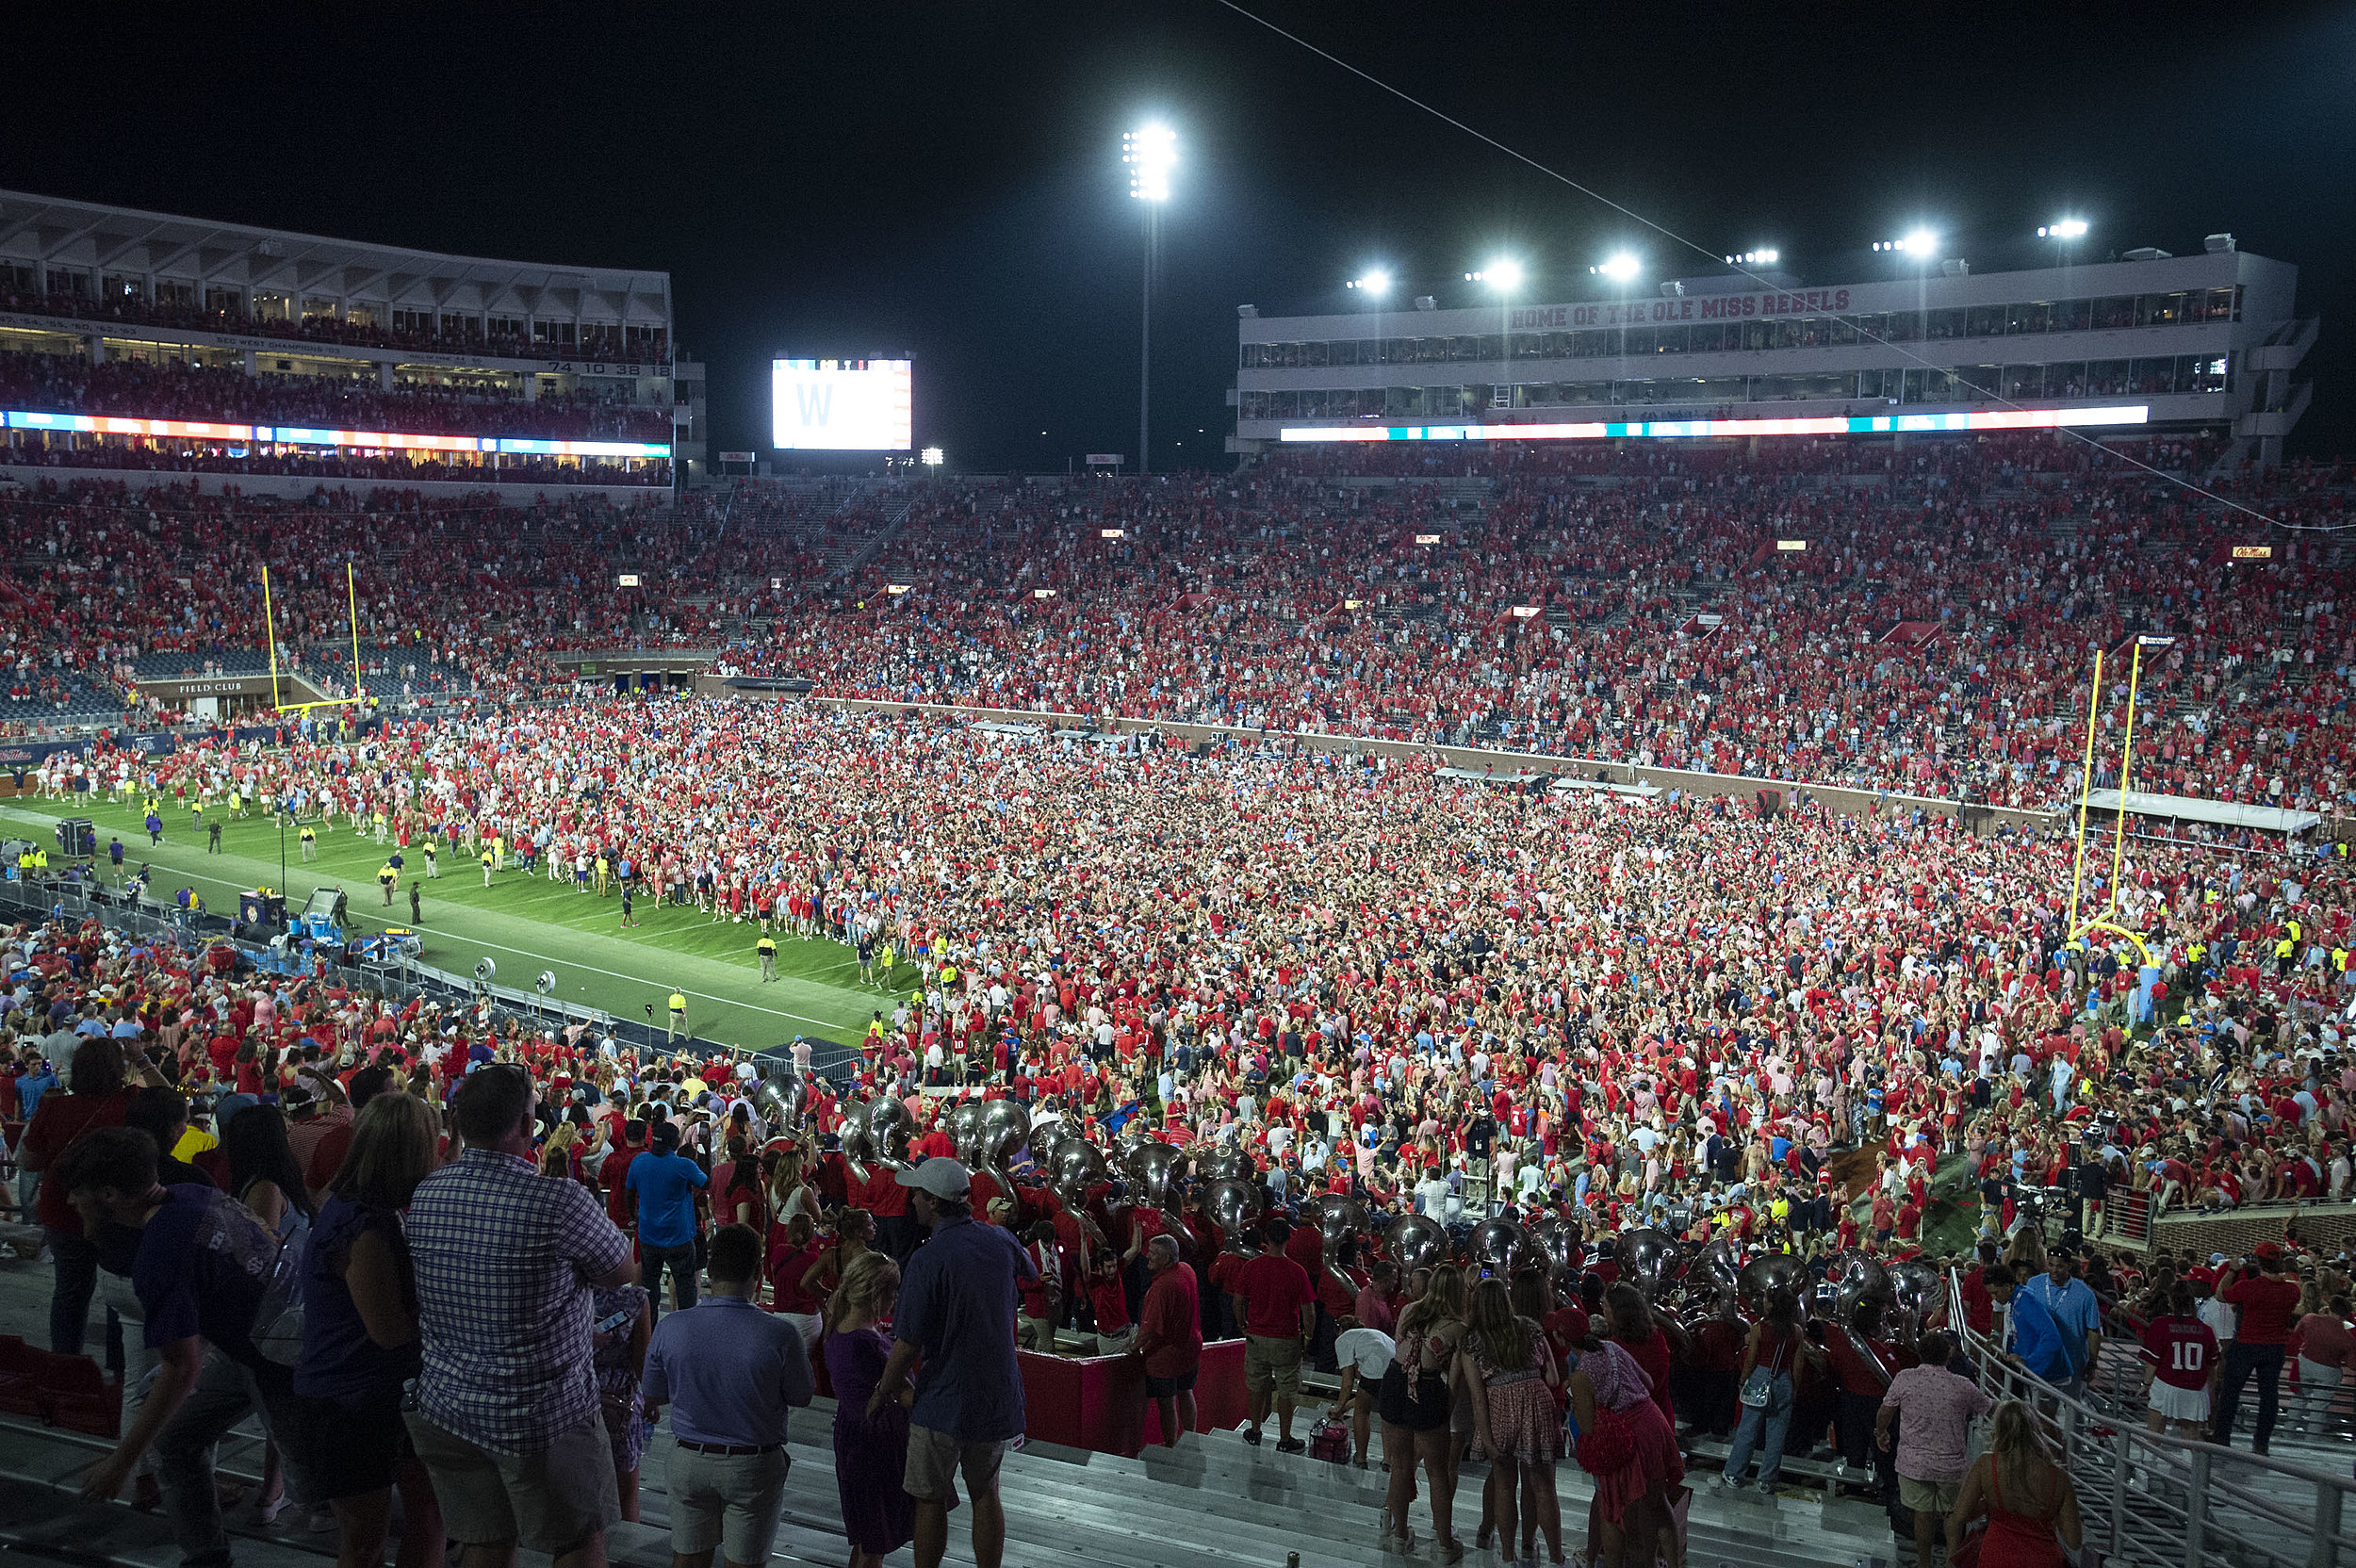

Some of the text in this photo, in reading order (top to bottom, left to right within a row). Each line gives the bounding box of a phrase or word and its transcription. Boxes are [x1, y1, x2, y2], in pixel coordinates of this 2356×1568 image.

[1511, 288, 1851, 330] HOME OF THE OLE MISS REBELS
[217, 336, 237, 345] SEC
[239, 339, 265, 348] WEST
[548, 362, 670, 377] 74 10 38 18
[795, 383, 833, 427] W
[179, 682, 242, 694] FIELD CLUB
[954, 1039, 964, 1050] 10
[1513, 1115, 1520, 1126] 4
[2171, 1341, 2203, 1371] 10
